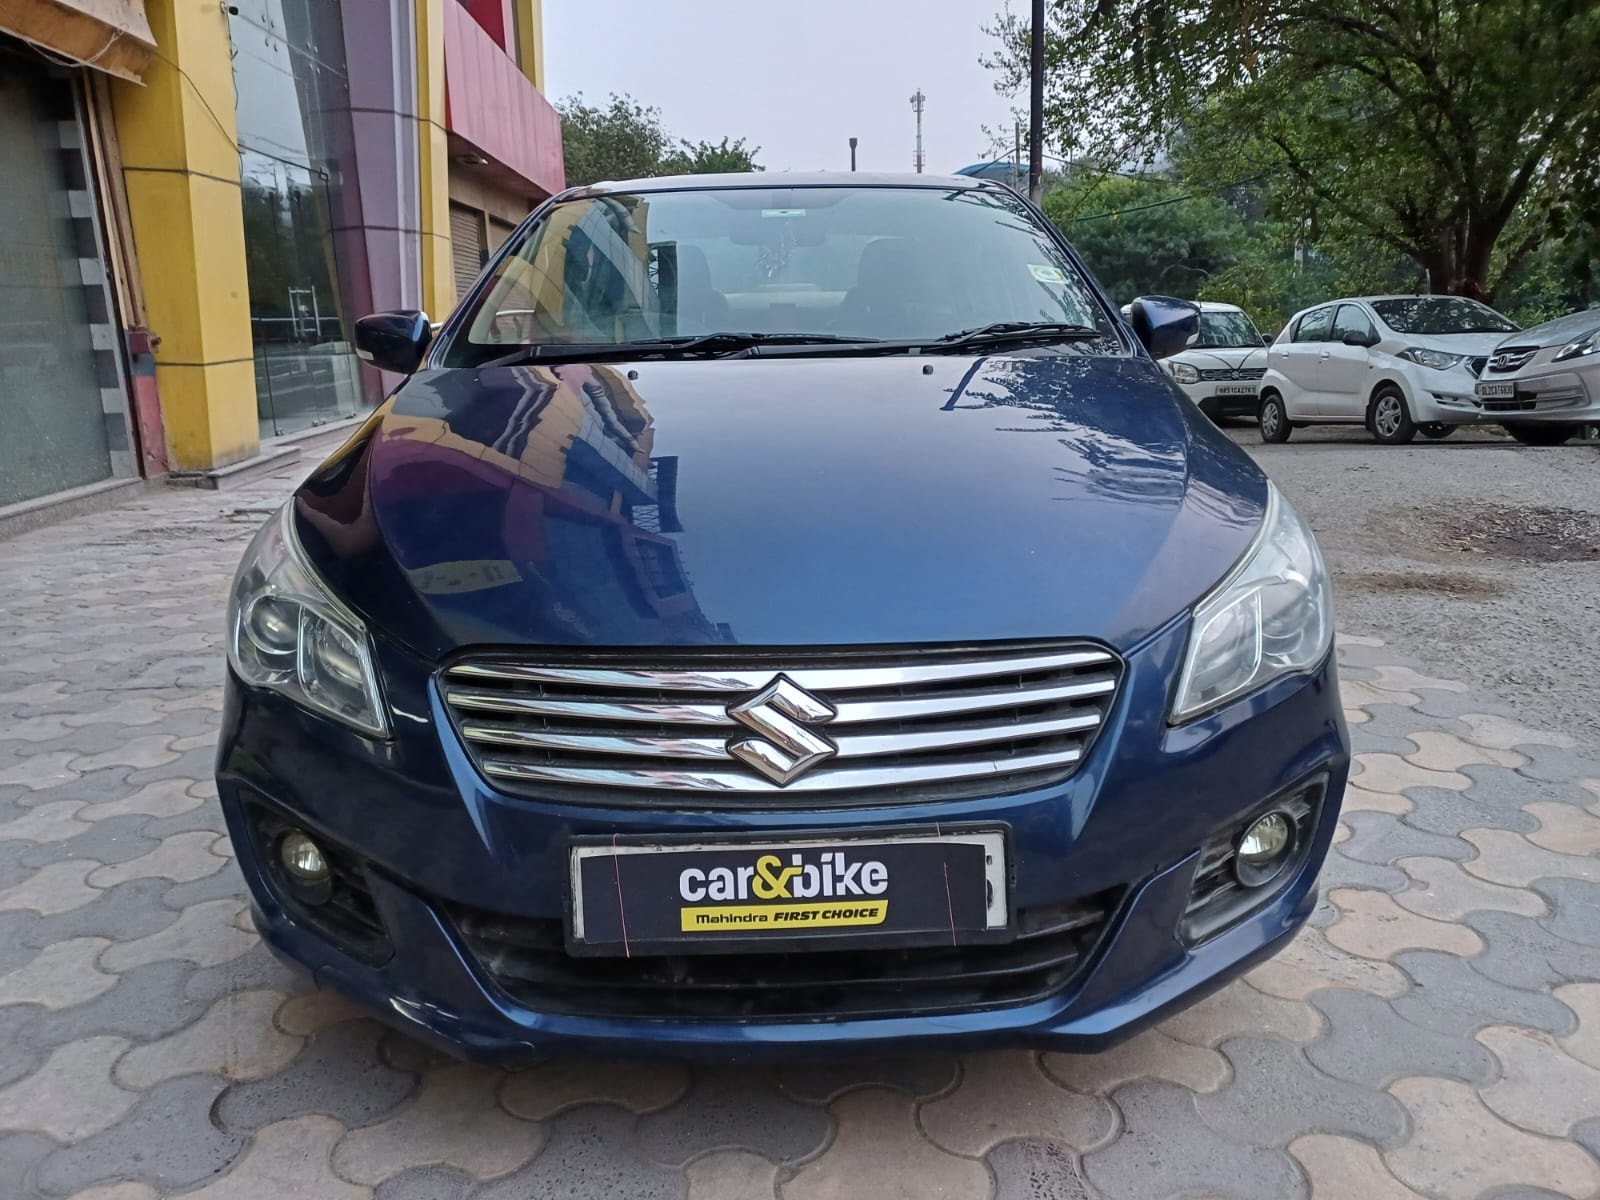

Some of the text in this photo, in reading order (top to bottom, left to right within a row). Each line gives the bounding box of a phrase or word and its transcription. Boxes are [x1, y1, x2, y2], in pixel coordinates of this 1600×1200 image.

[679, 852, 889, 902] car&bike
[696, 908, 879, 924] Mahindra FIRST CHOICE
